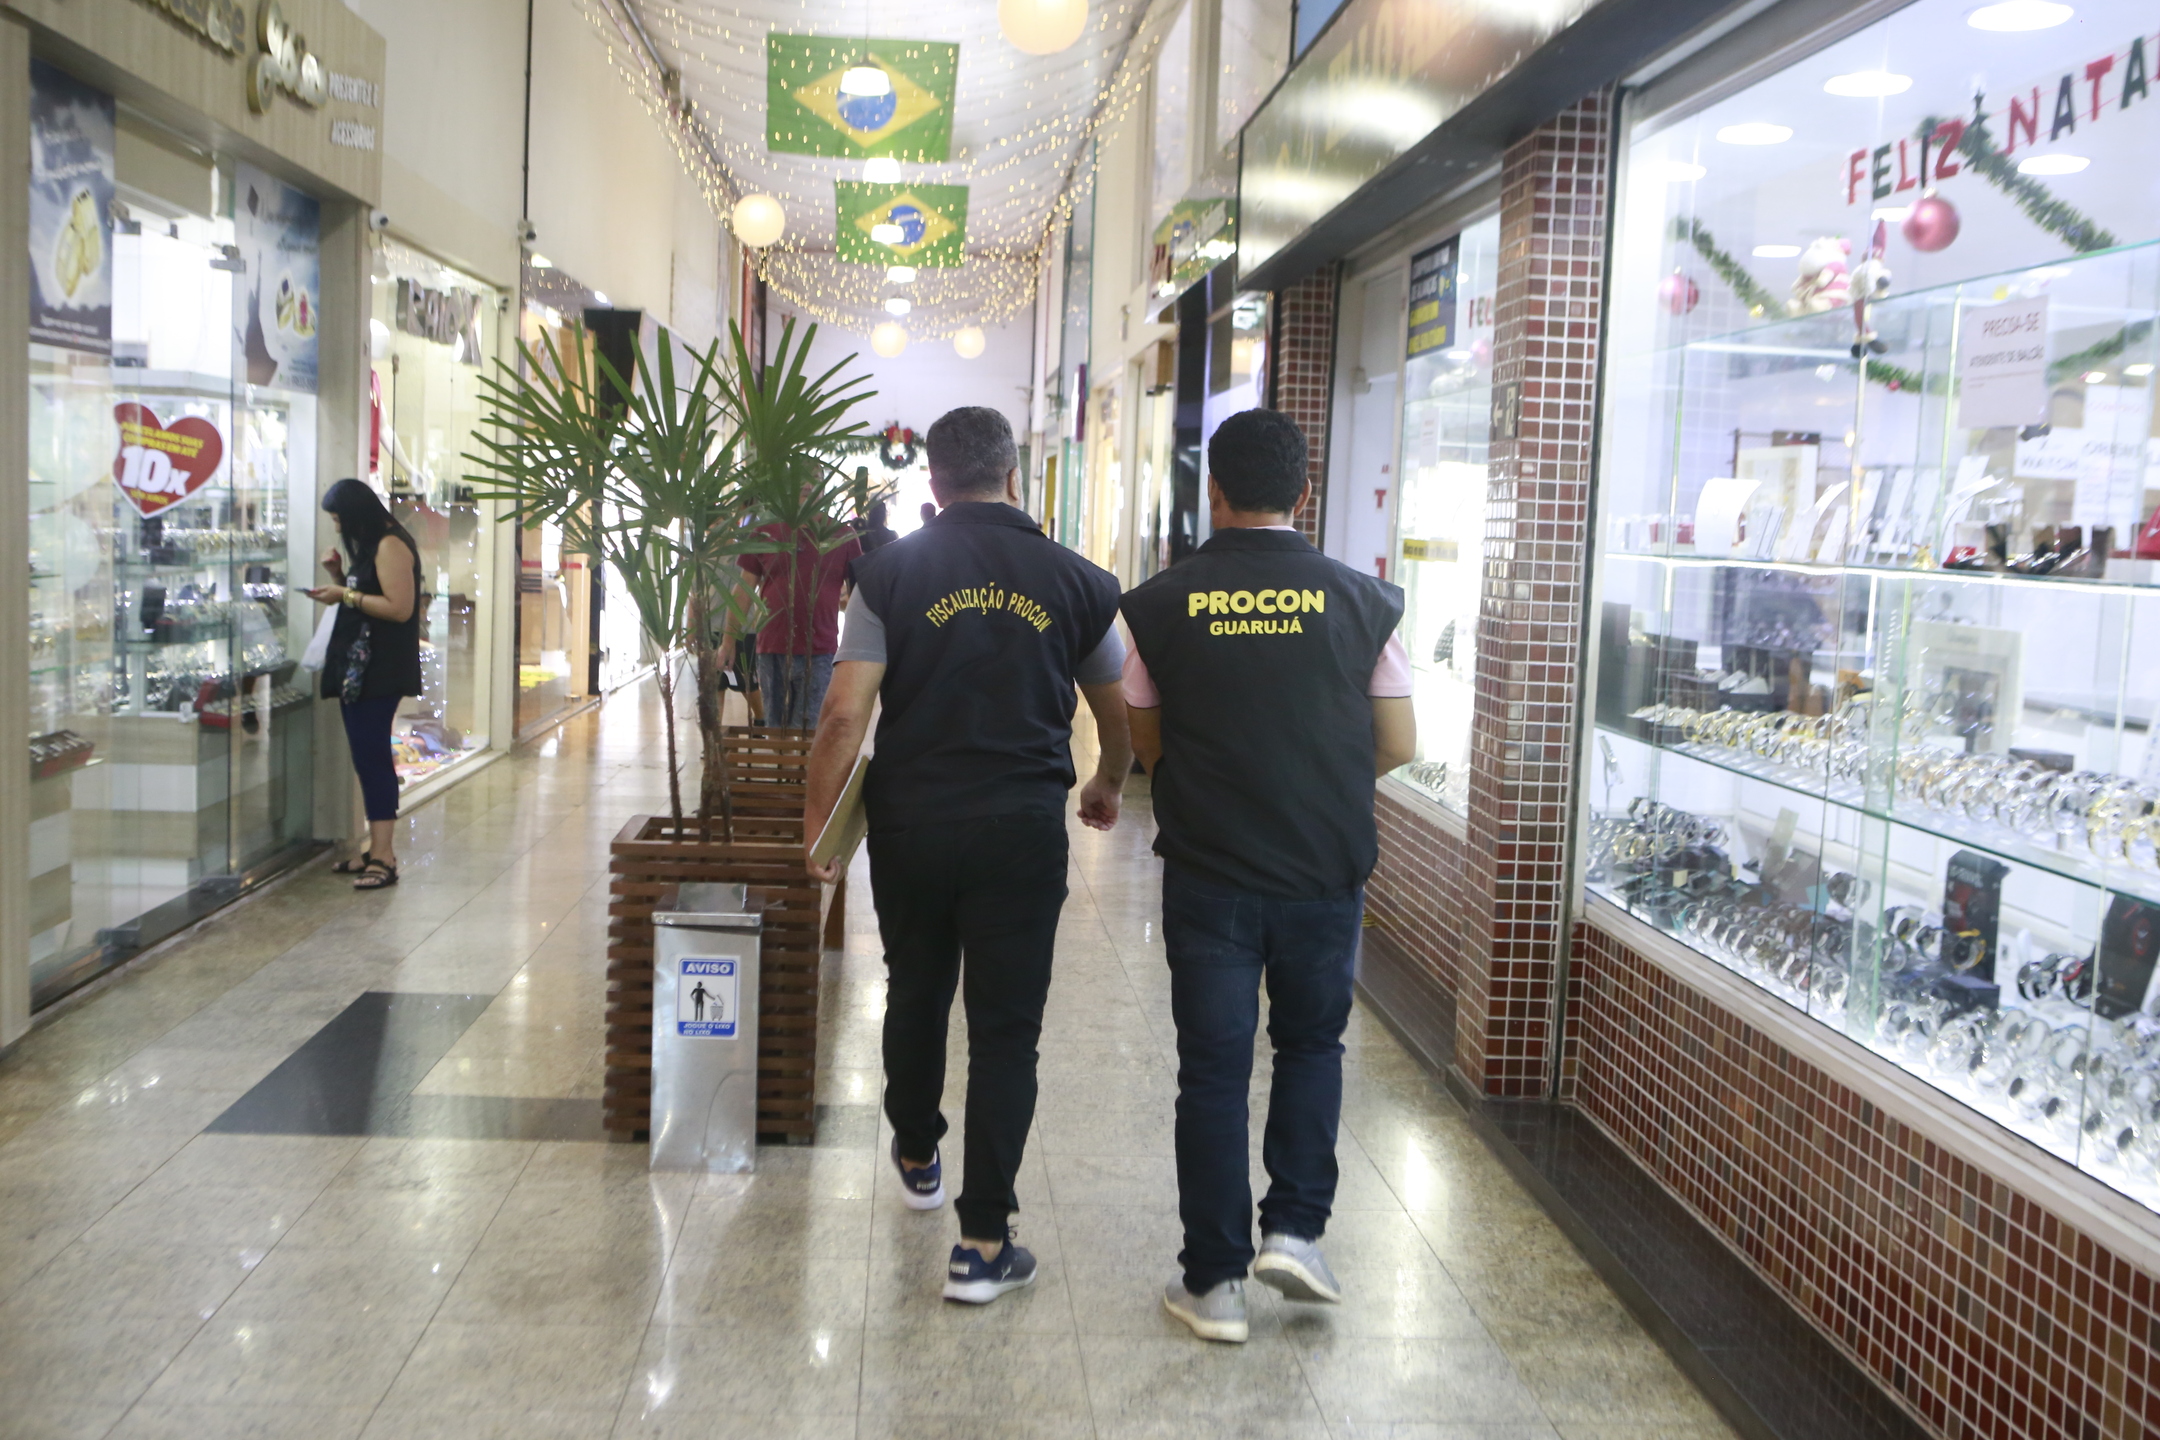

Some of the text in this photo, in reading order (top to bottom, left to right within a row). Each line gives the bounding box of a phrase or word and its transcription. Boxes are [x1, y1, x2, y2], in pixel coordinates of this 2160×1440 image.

[1848, 34, 2160, 206] FELIZ NATA
[1982, 311, 2041, 338] PRECISA-SE
[926, 581, 1053, 632] FISCALIZAÇÃO PROCON
[1188, 588, 1325, 617] PROCON
[1209, 616, 1303, 636] GUARUJÁ
[685, 962, 731, 974] AVISO
